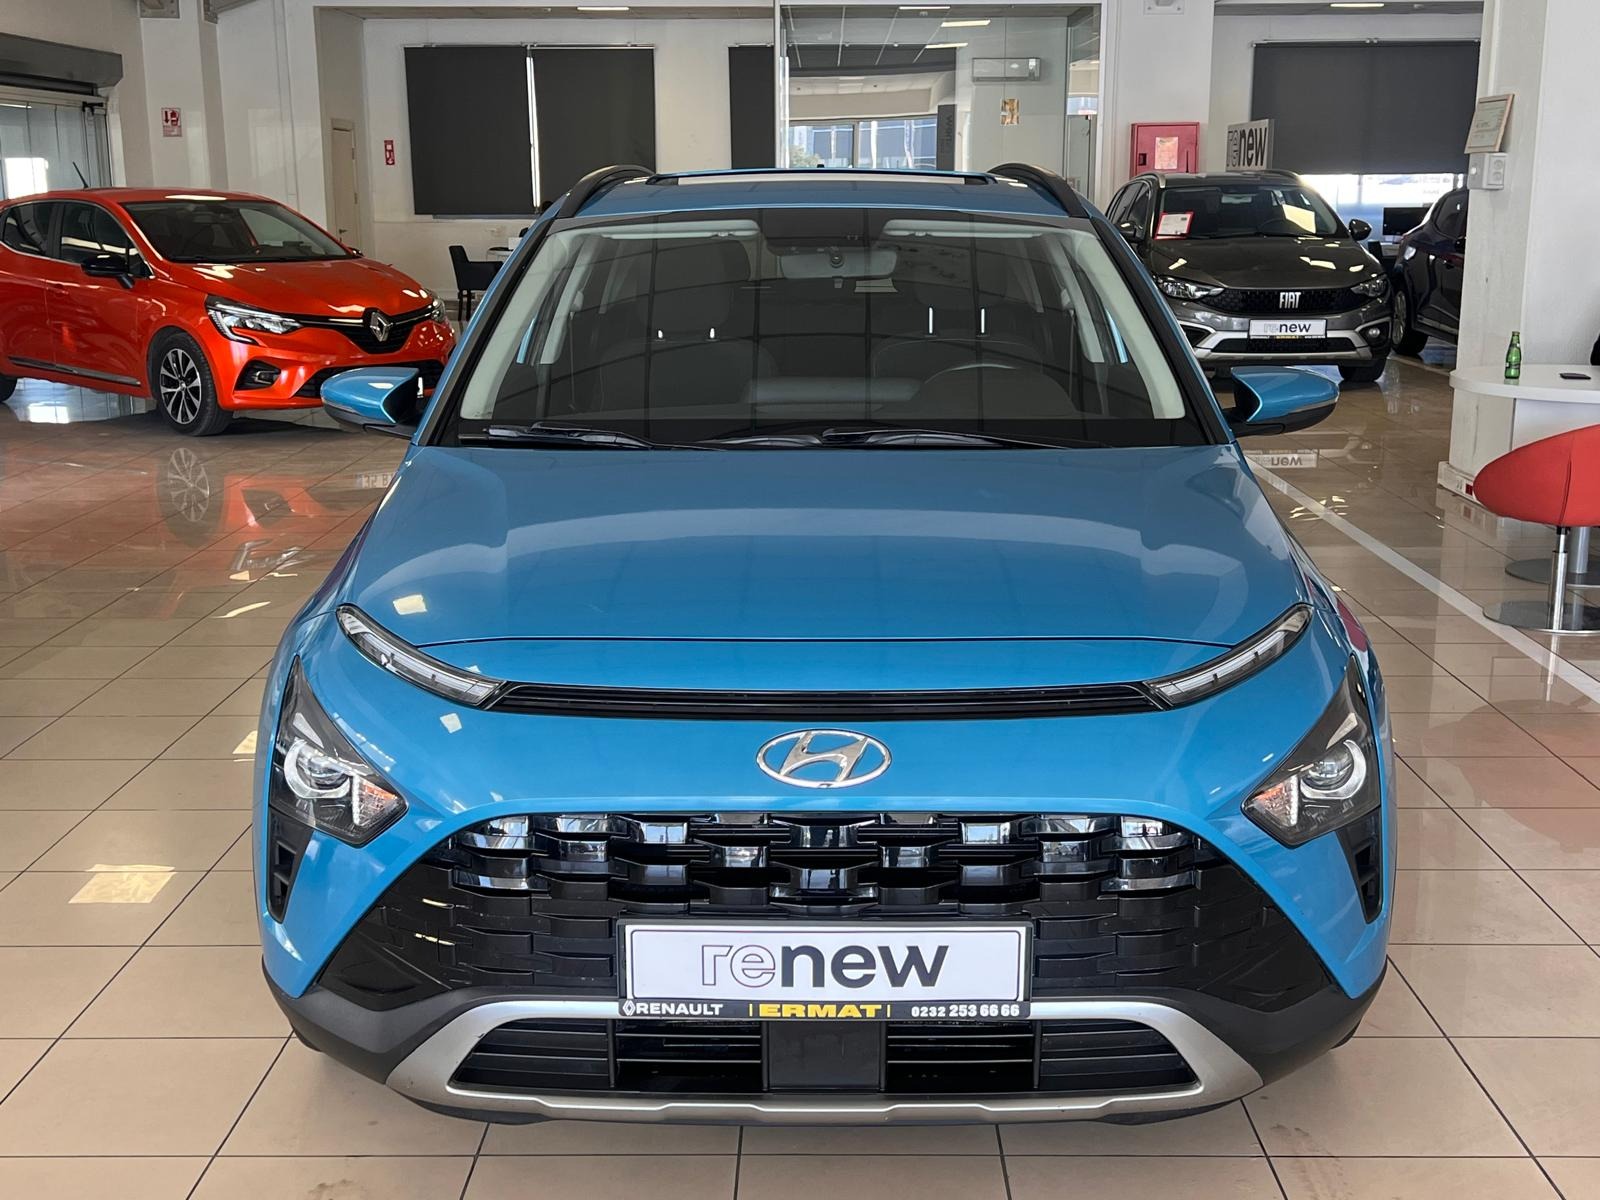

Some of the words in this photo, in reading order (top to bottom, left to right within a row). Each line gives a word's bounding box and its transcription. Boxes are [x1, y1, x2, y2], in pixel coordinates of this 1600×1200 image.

[1279, 291, 1301, 309] FIAT
[701, 944, 949, 988] renew
[636, 1003, 723, 1016] RENAULT
[759, 1003, 881, 1018] ERMAT
[911, 1006, 945, 1017] 0232
[948, 1004, 977, 1017] 253
